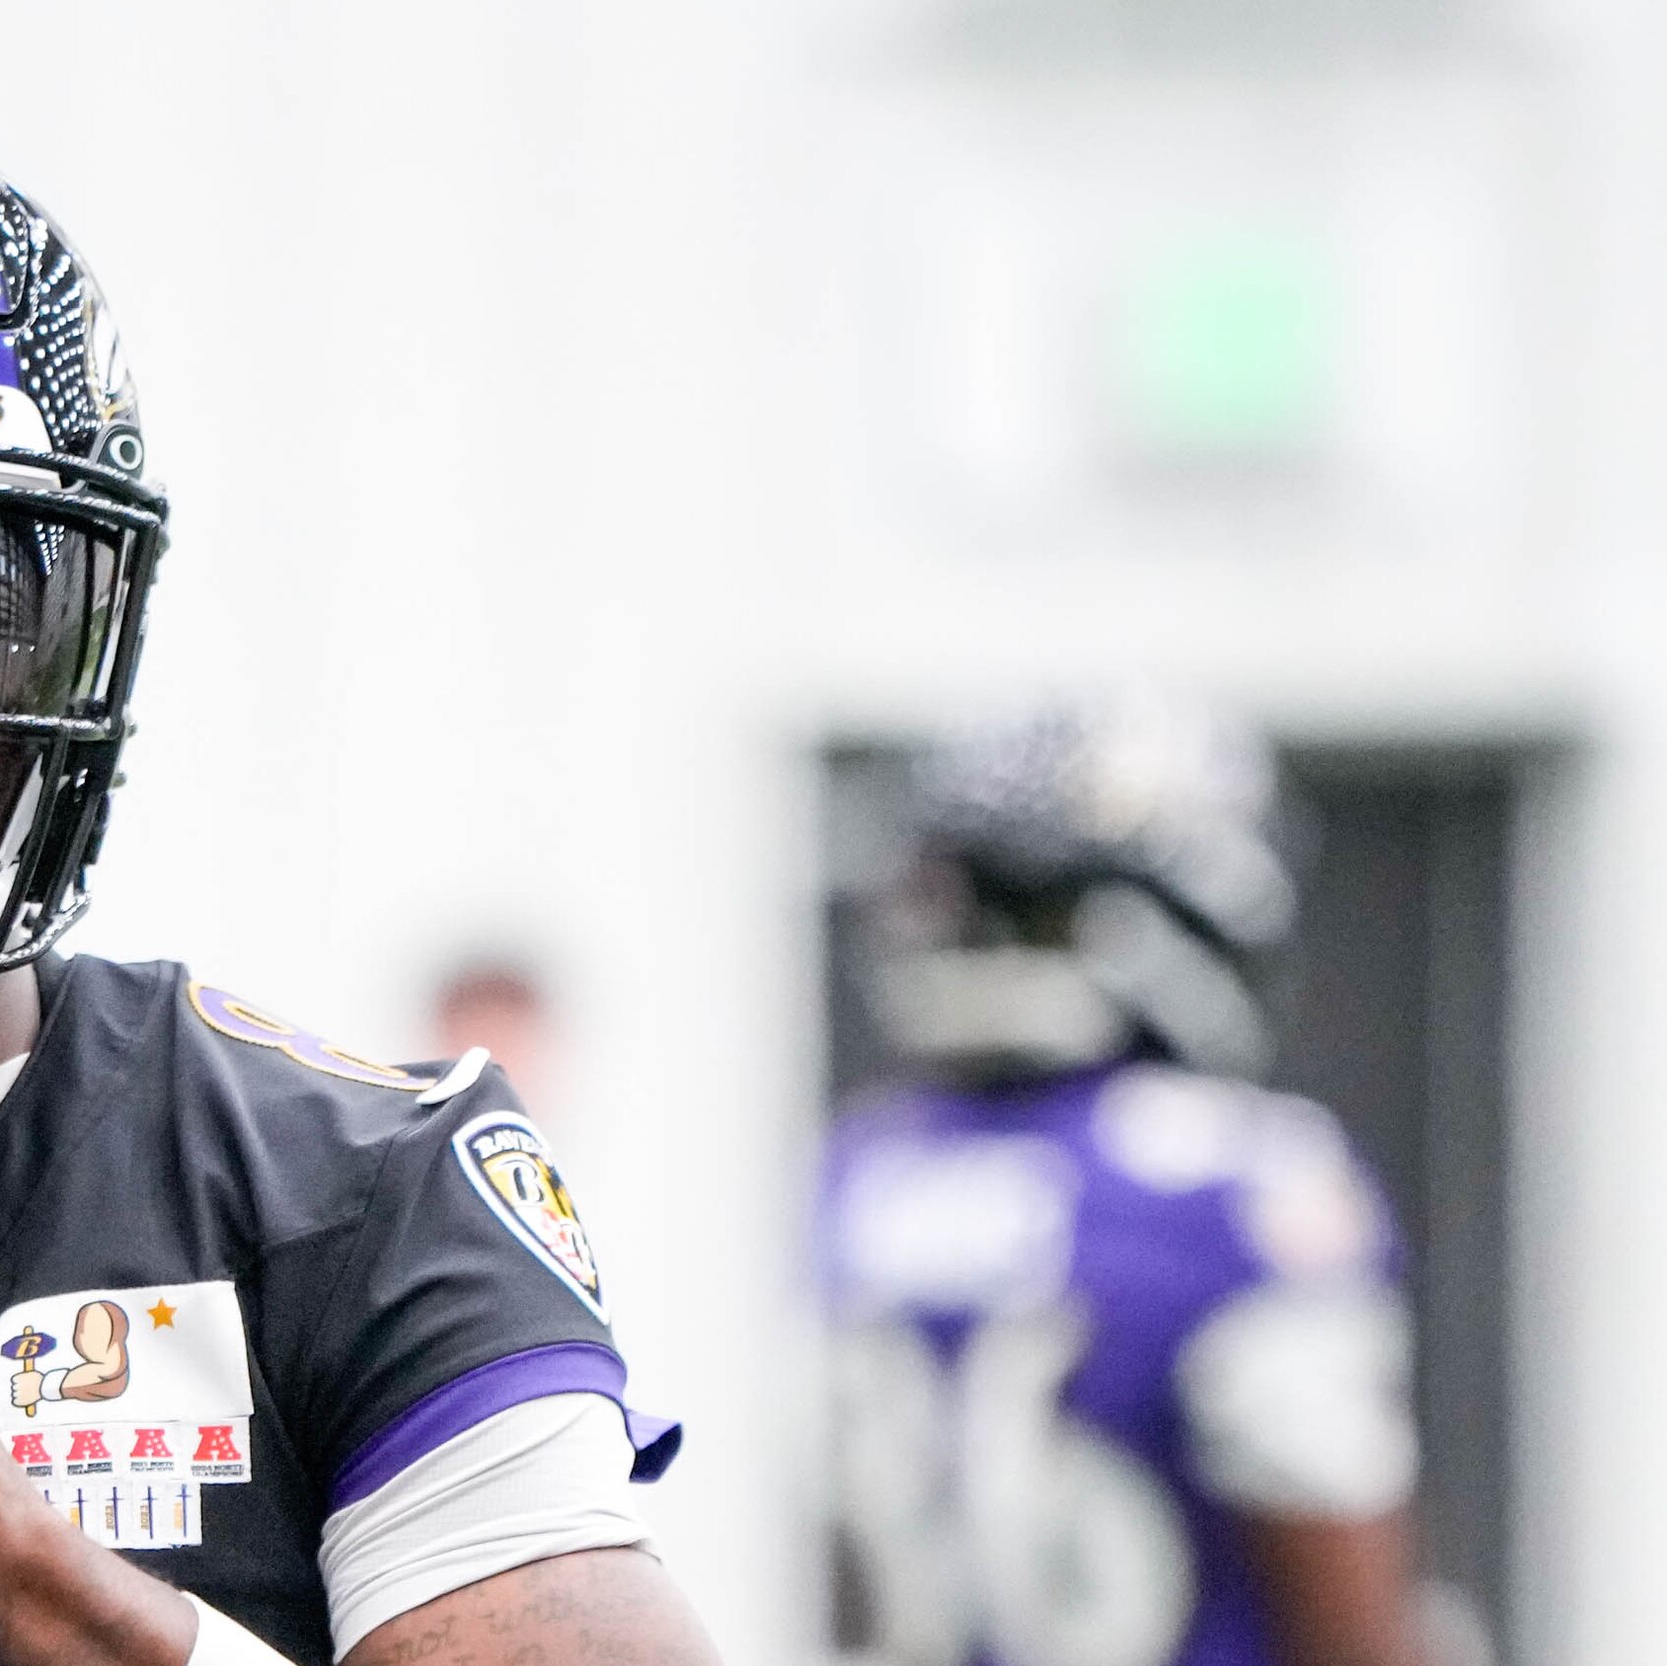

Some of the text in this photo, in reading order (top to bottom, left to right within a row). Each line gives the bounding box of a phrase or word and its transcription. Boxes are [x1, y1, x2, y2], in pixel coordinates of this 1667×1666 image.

[66, 1429, 112, 1461] A
[130, 1428, 174, 1458] A
[192, 1425, 242, 1461] A
